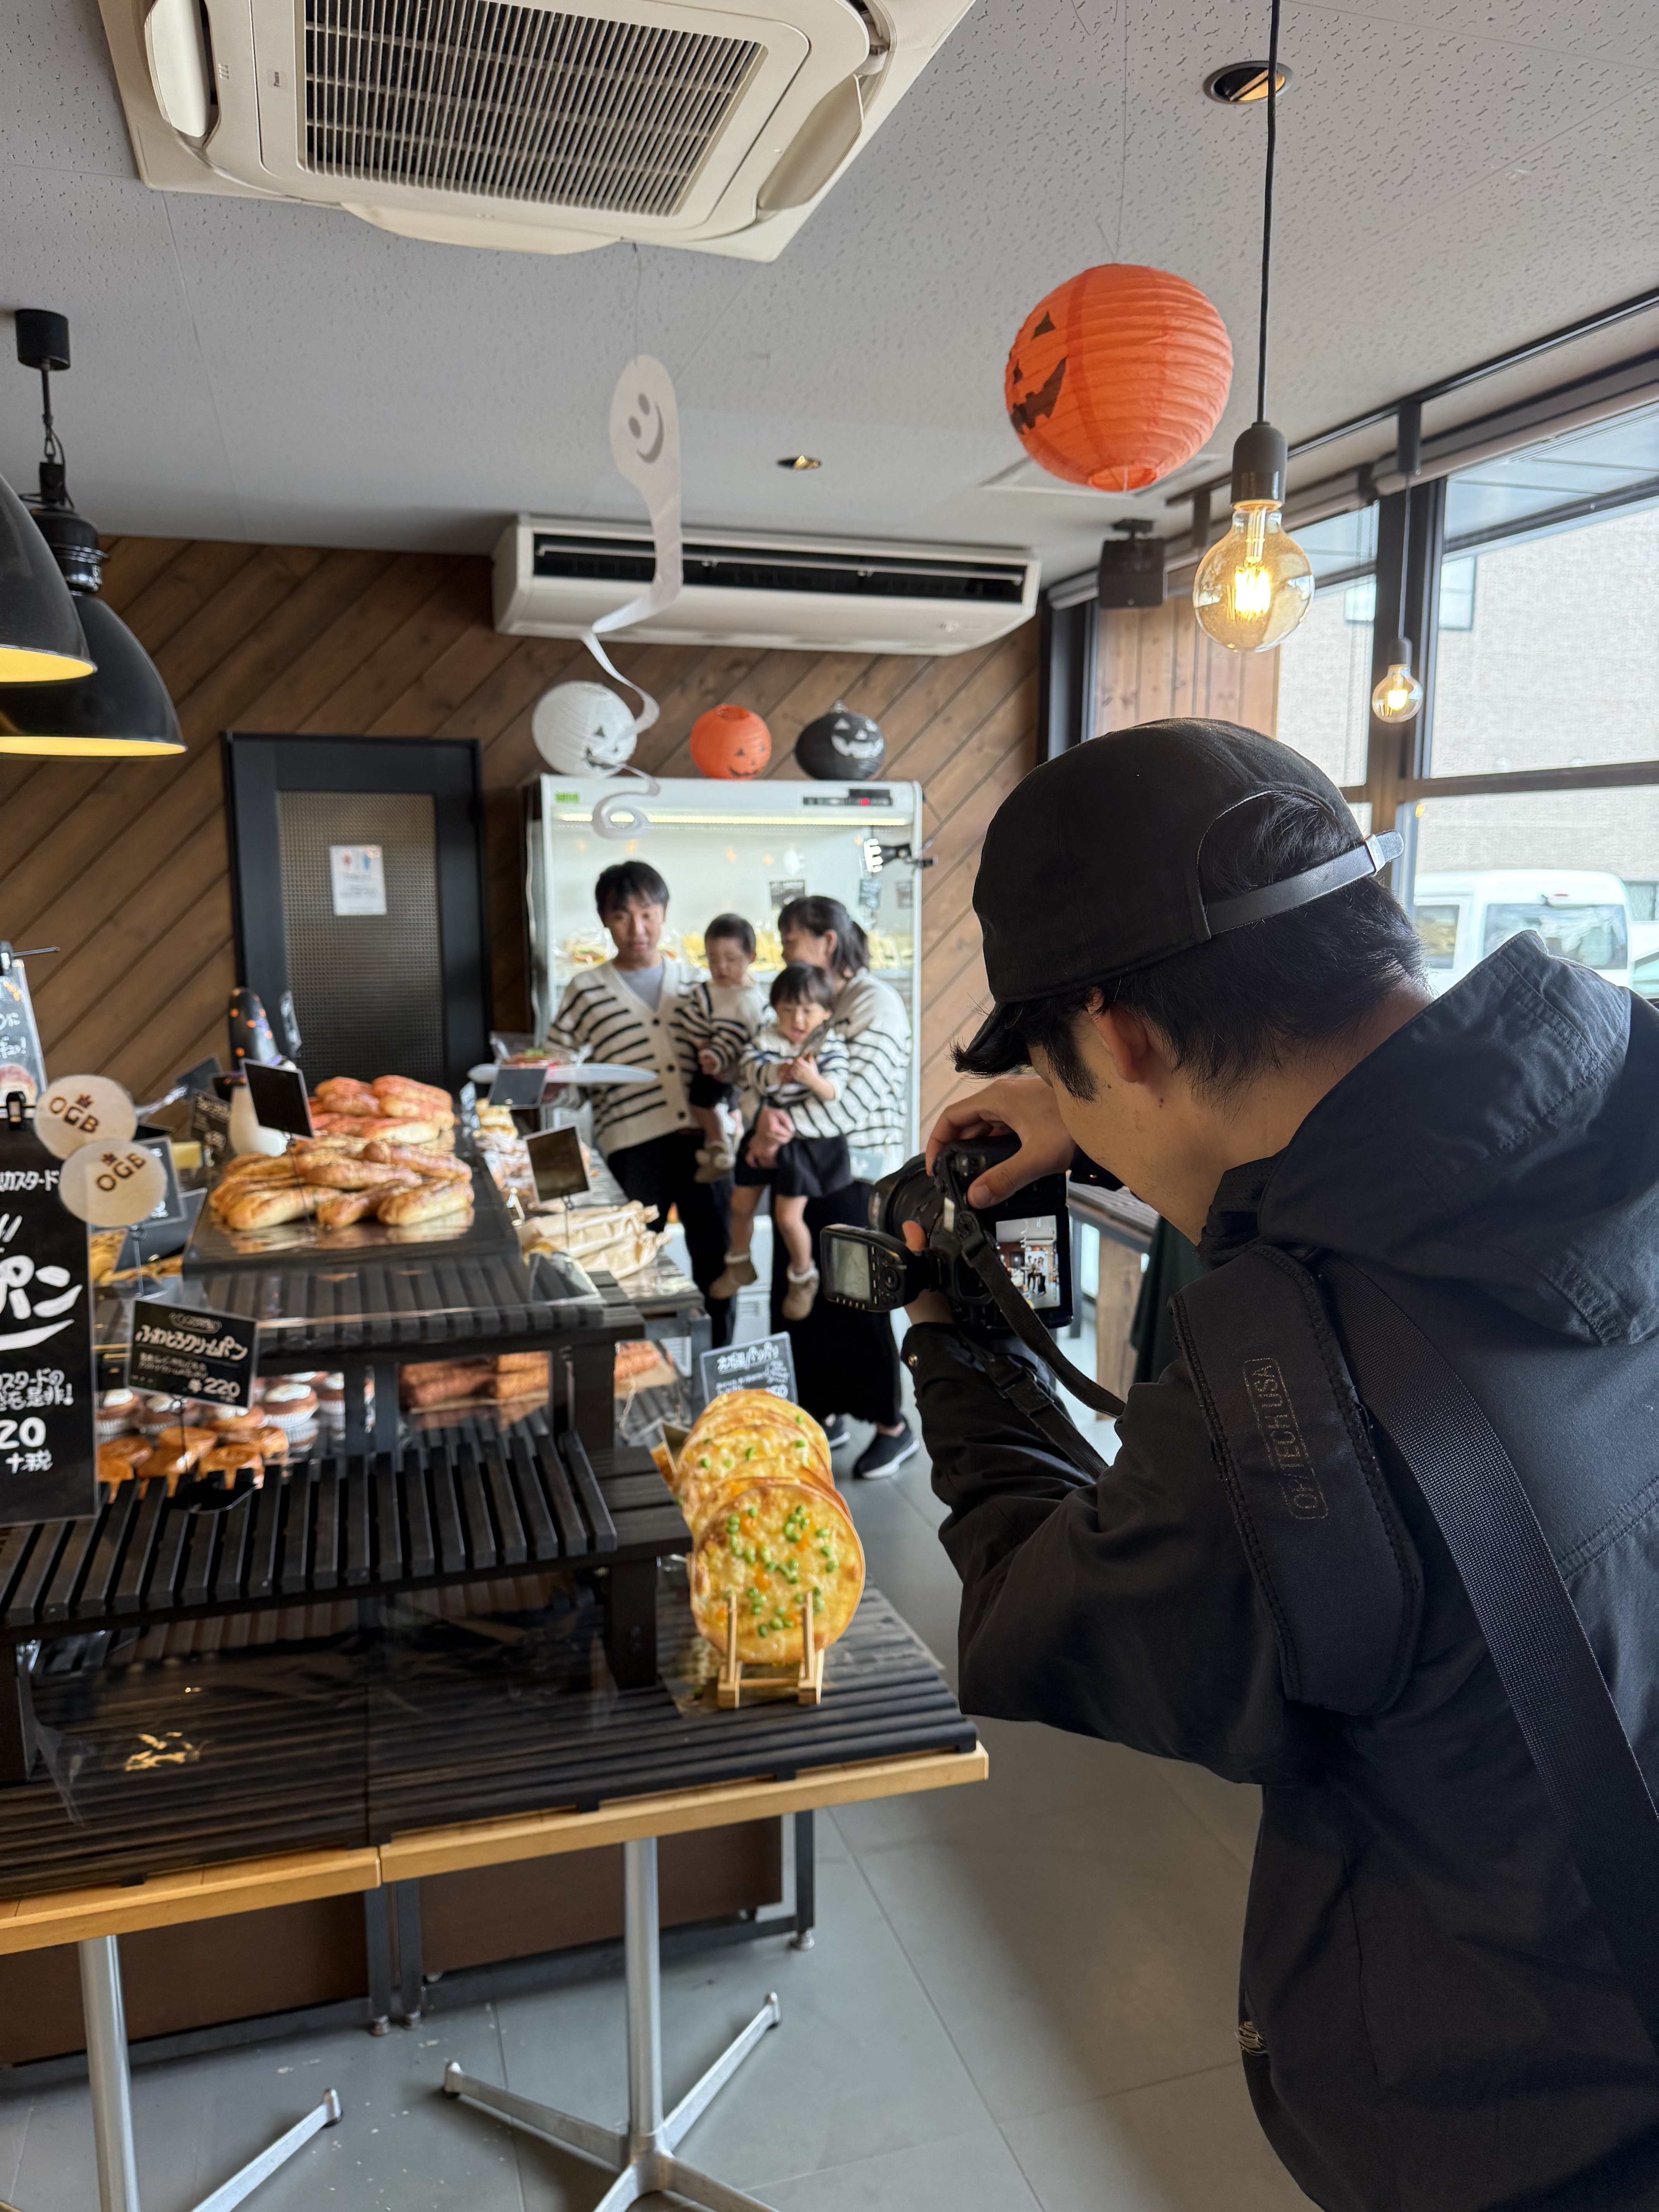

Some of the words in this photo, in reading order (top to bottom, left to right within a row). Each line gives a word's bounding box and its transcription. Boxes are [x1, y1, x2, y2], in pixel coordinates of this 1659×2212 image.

[48, 1096, 99, 1133] OGB
[96, 1153, 147, 1191] OGB
[1252, 1364, 1283, 1408] USA
